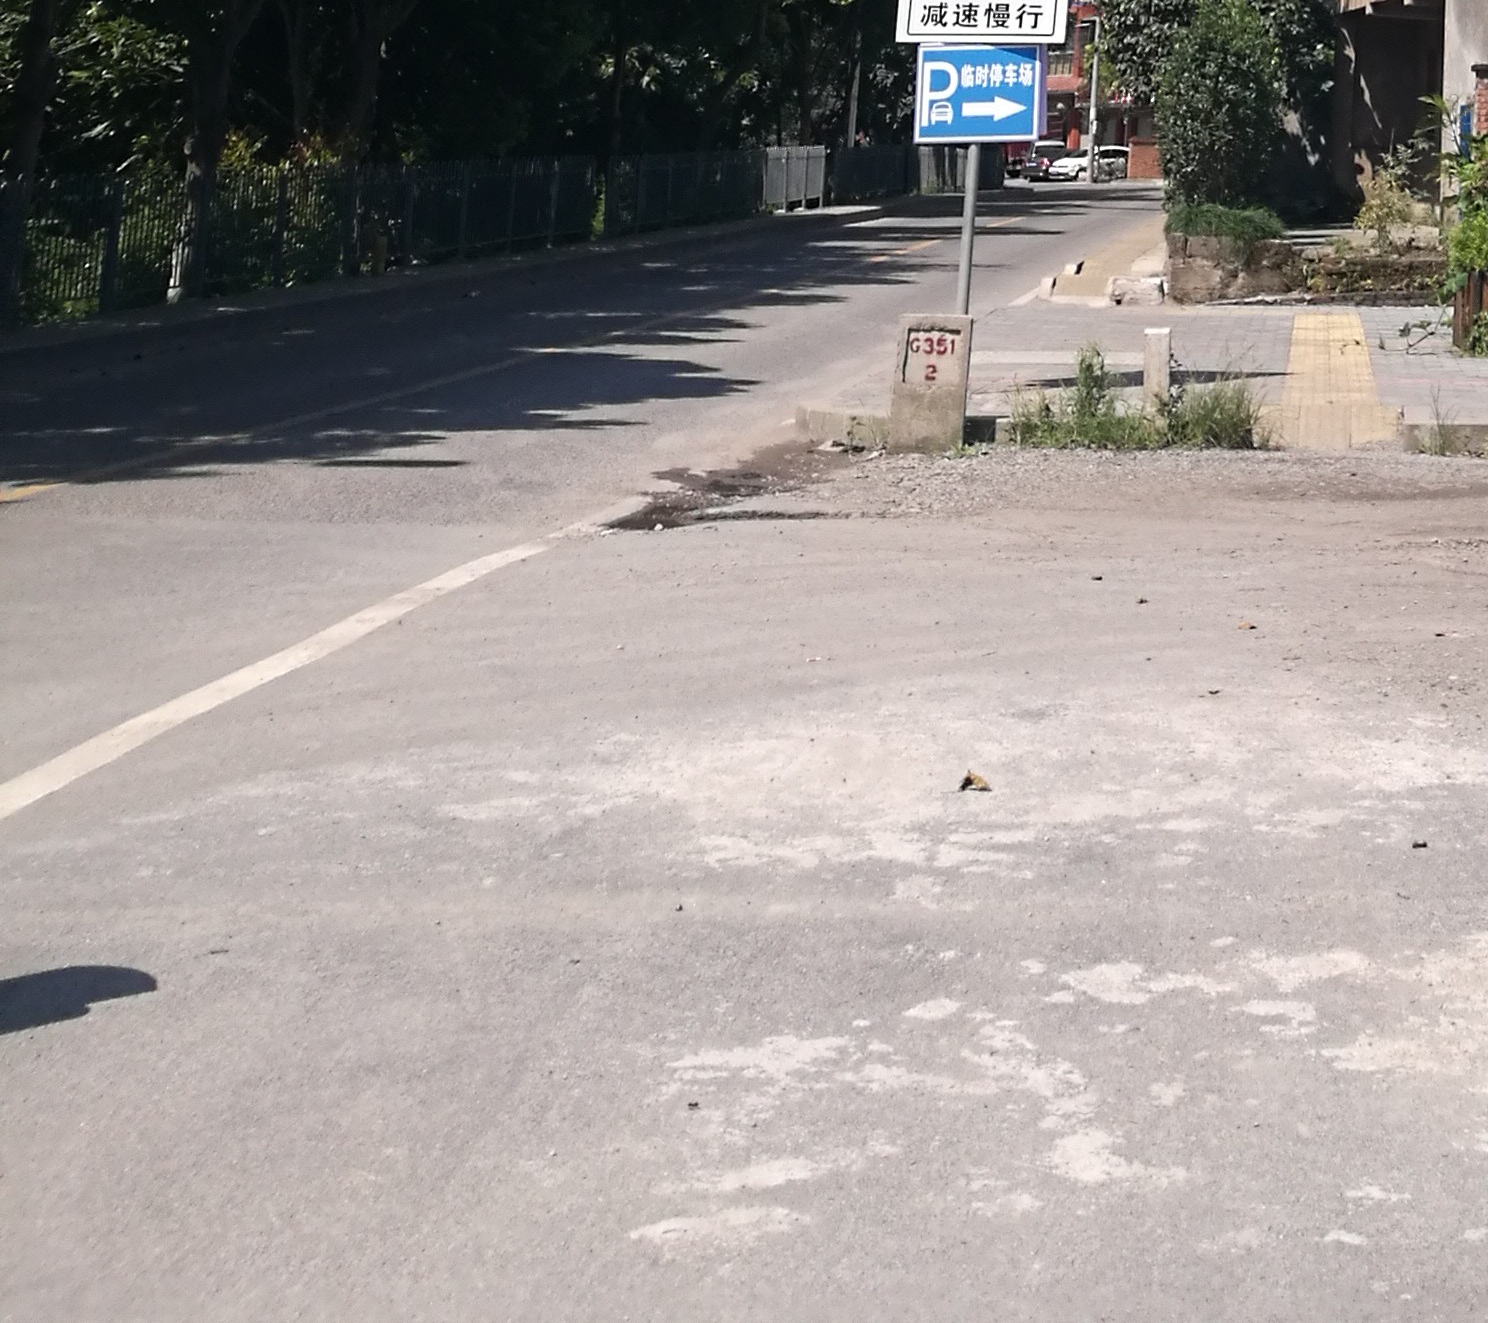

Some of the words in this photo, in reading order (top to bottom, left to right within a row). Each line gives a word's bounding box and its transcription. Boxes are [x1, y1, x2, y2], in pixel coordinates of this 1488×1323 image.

[920, 2, 1044, 29] 减速慢行
[961, 63, 1033, 88] 临时停车场
[921, 61, 959, 127] P
[909, 335, 956, 356] G351
[924, 364, 938, 381] 2
